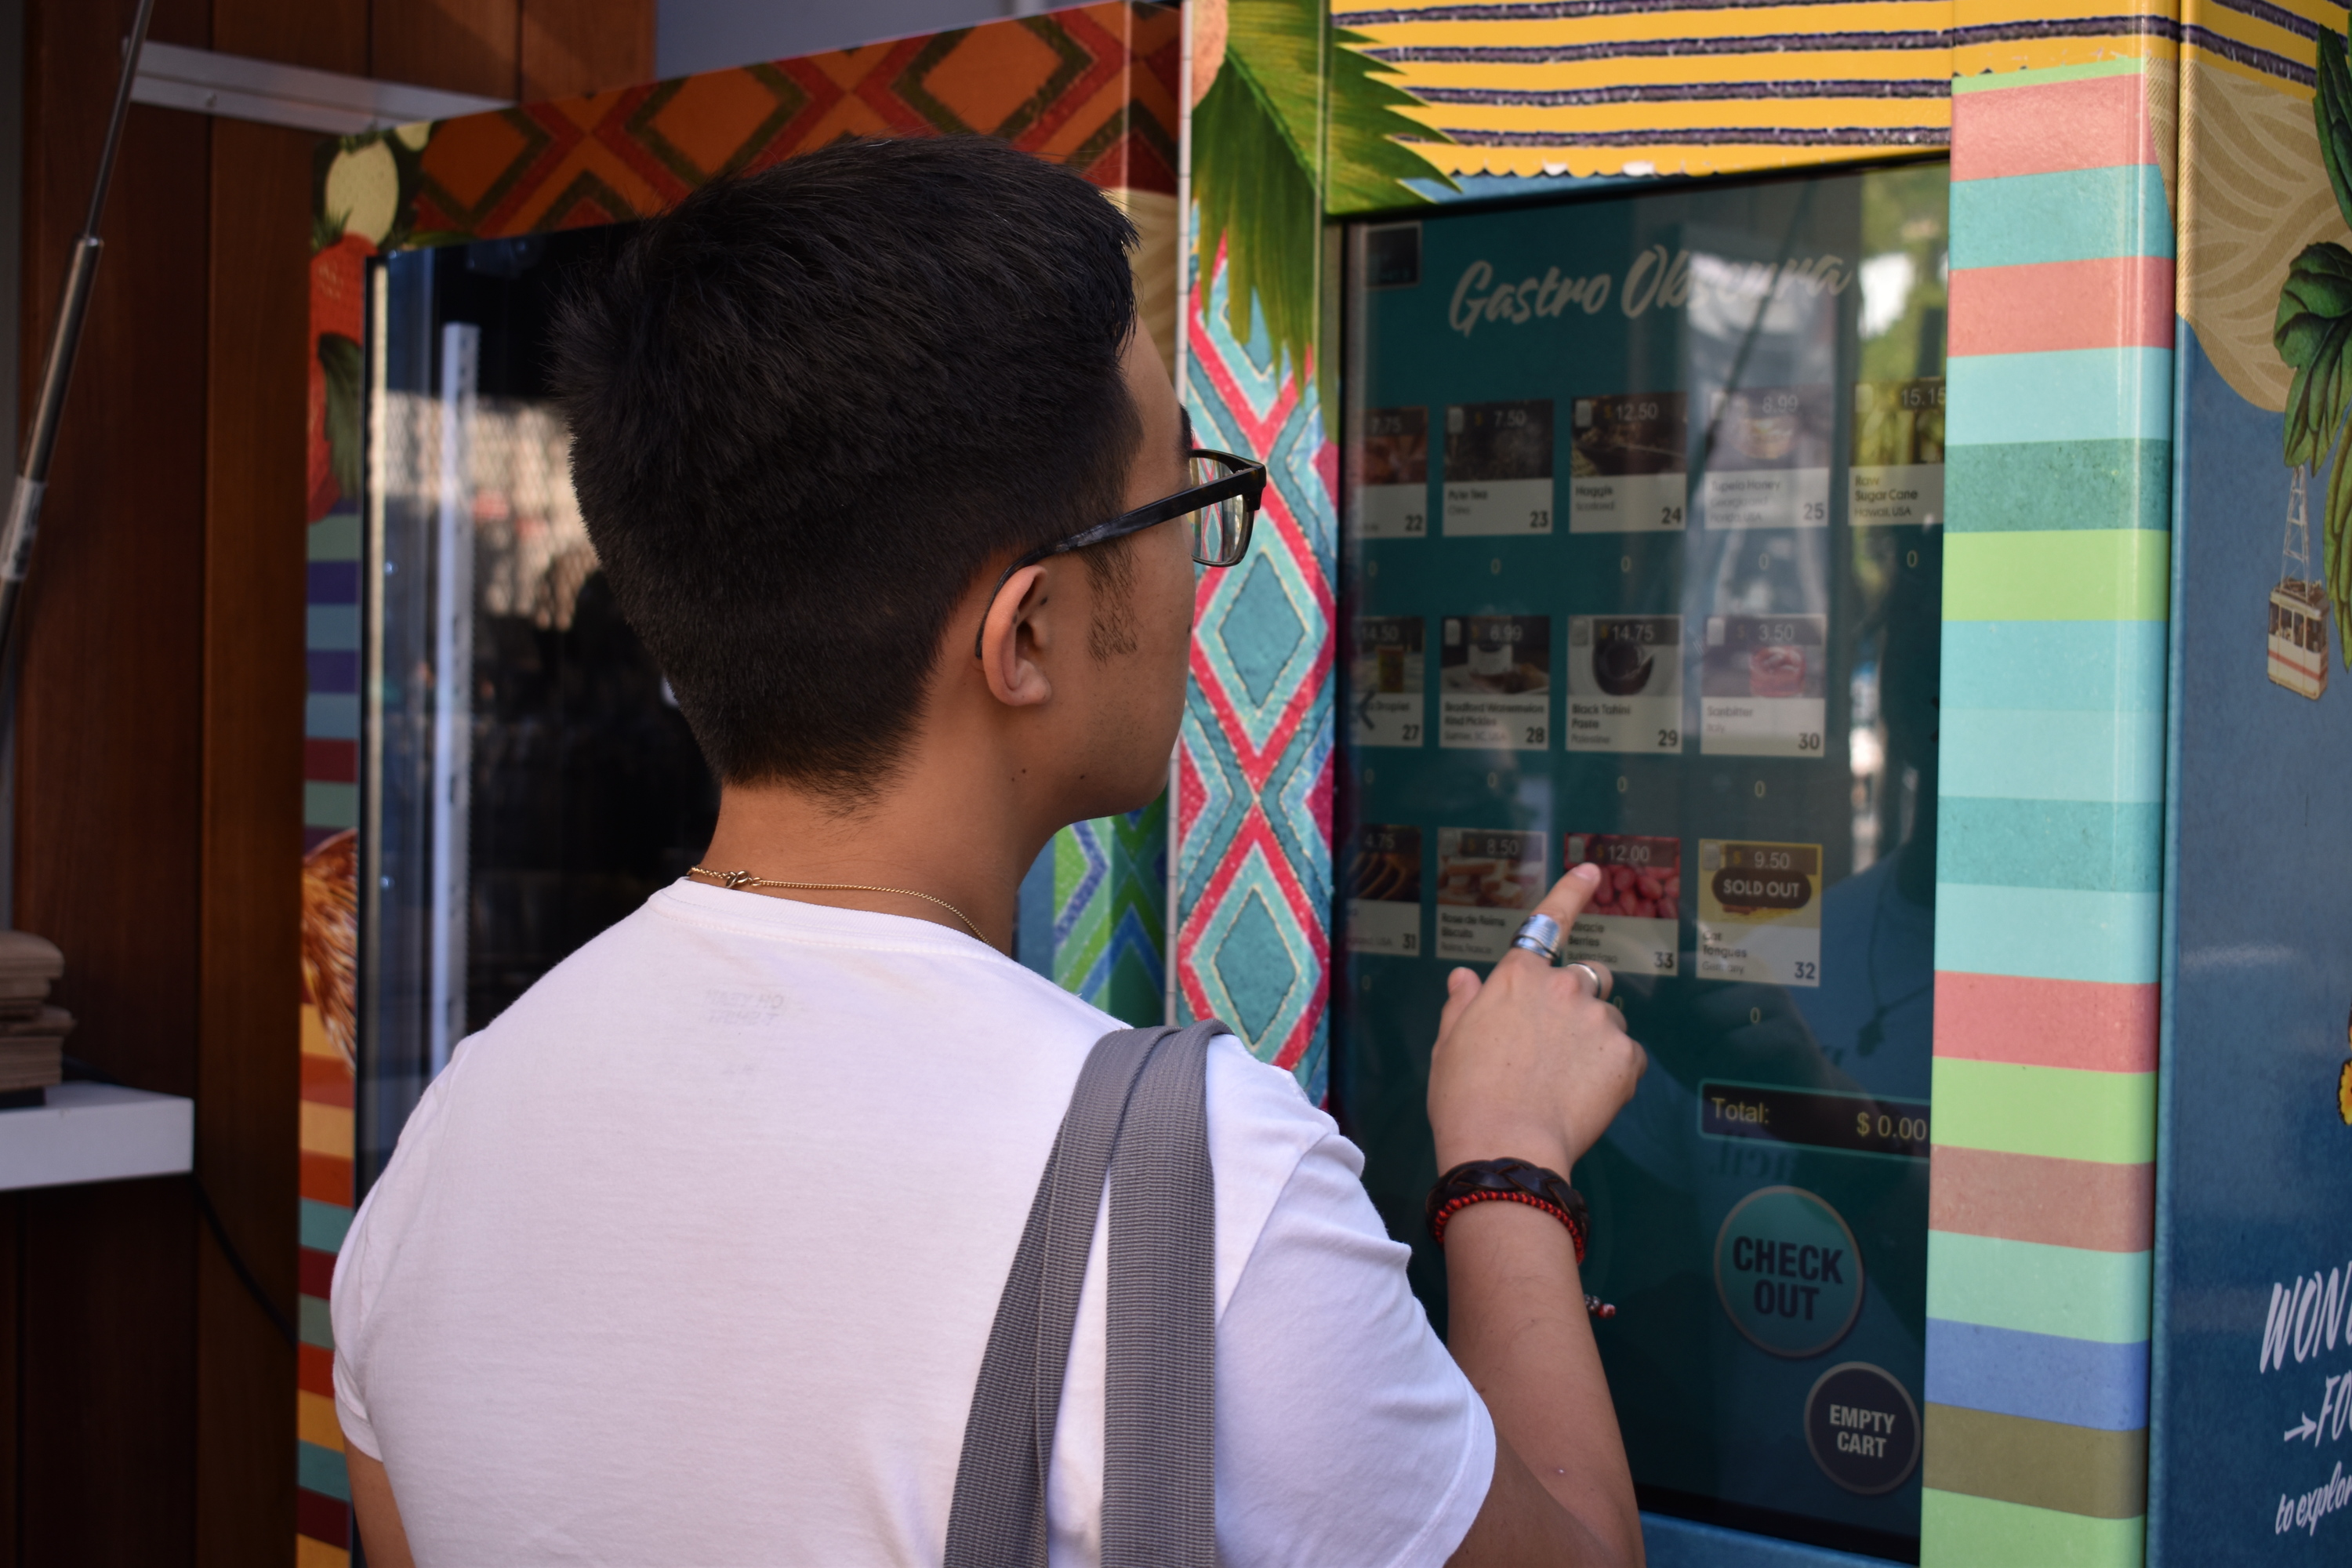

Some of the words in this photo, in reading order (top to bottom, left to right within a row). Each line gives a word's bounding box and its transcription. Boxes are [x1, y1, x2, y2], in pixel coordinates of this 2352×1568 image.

[1448, 260, 1612, 339] Gastro
[1762, 394, 1798, 413] 8.99
[1901, 386, 1946, 407] 15.15
[1494, 408, 1527, 428] 7.50
[1616, 401, 1659, 421] 12.50
[1747, 478, 1780, 492] Honey
[1854, 474, 1879, 487] Raw
[1854, 488, 1886, 503] Sugar
[1888, 488, 1918, 501] Cane
[1529, 510, 1549, 529] 23
[1661, 506, 1682, 524] 24
[1803, 502, 1824, 521] 25
[1404, 514, 1423, 532] 22
[1491, 557, 1501, 575] 0
[1621, 554, 1632, 574] 0
[1759, 553, 1769, 571] 0
[1907, 550, 1918, 568] 0
[1612, 623, 1654, 642] 14.75
[1759, 624, 1795, 641] 3.50
[1402, 724, 1420, 740] 27
[1526, 727, 1545, 744] 28
[1657, 729, 1679, 747] 29
[1798, 733, 1820, 750] 30
[1487, 771, 1498, 789] 0
[1617, 775, 1628, 794] 0
[1754, 779, 1766, 798] 0
[1364, 833, 1396, 850] 4.75
[1486, 837, 1519, 856] 8.50
[1608, 844, 1650, 863] 12.00
[1754, 851, 1791, 870] 9.50
[1722, 879, 1762, 897] SOLD
[1765, 880, 1800, 898] OUT
[1402, 932, 1417, 949] 31
[1653, 951, 1674, 968] 33
[1701, 944, 1748, 959] Tongues
[1794, 961, 1816, 980] 32
[1750, 1006, 1761, 1024] 0
[1711, 1096, 1769, 1125] Total:
[1857, 1111, 1871, 1137] $
[1877, 1114, 1928, 1142] 0.00
[1732, 1235, 1845, 1285] CHECK
[1753, 1279, 1820, 1320] OUT
[2259, 1260, 2352, 1374] WON
[2314, 1370, 2352, 1448] FO
[1828, 1403, 1896, 1435] EMPTY
[1836, 1430, 1887, 1459] CART
[2274, 1493, 2295, 1535] to
